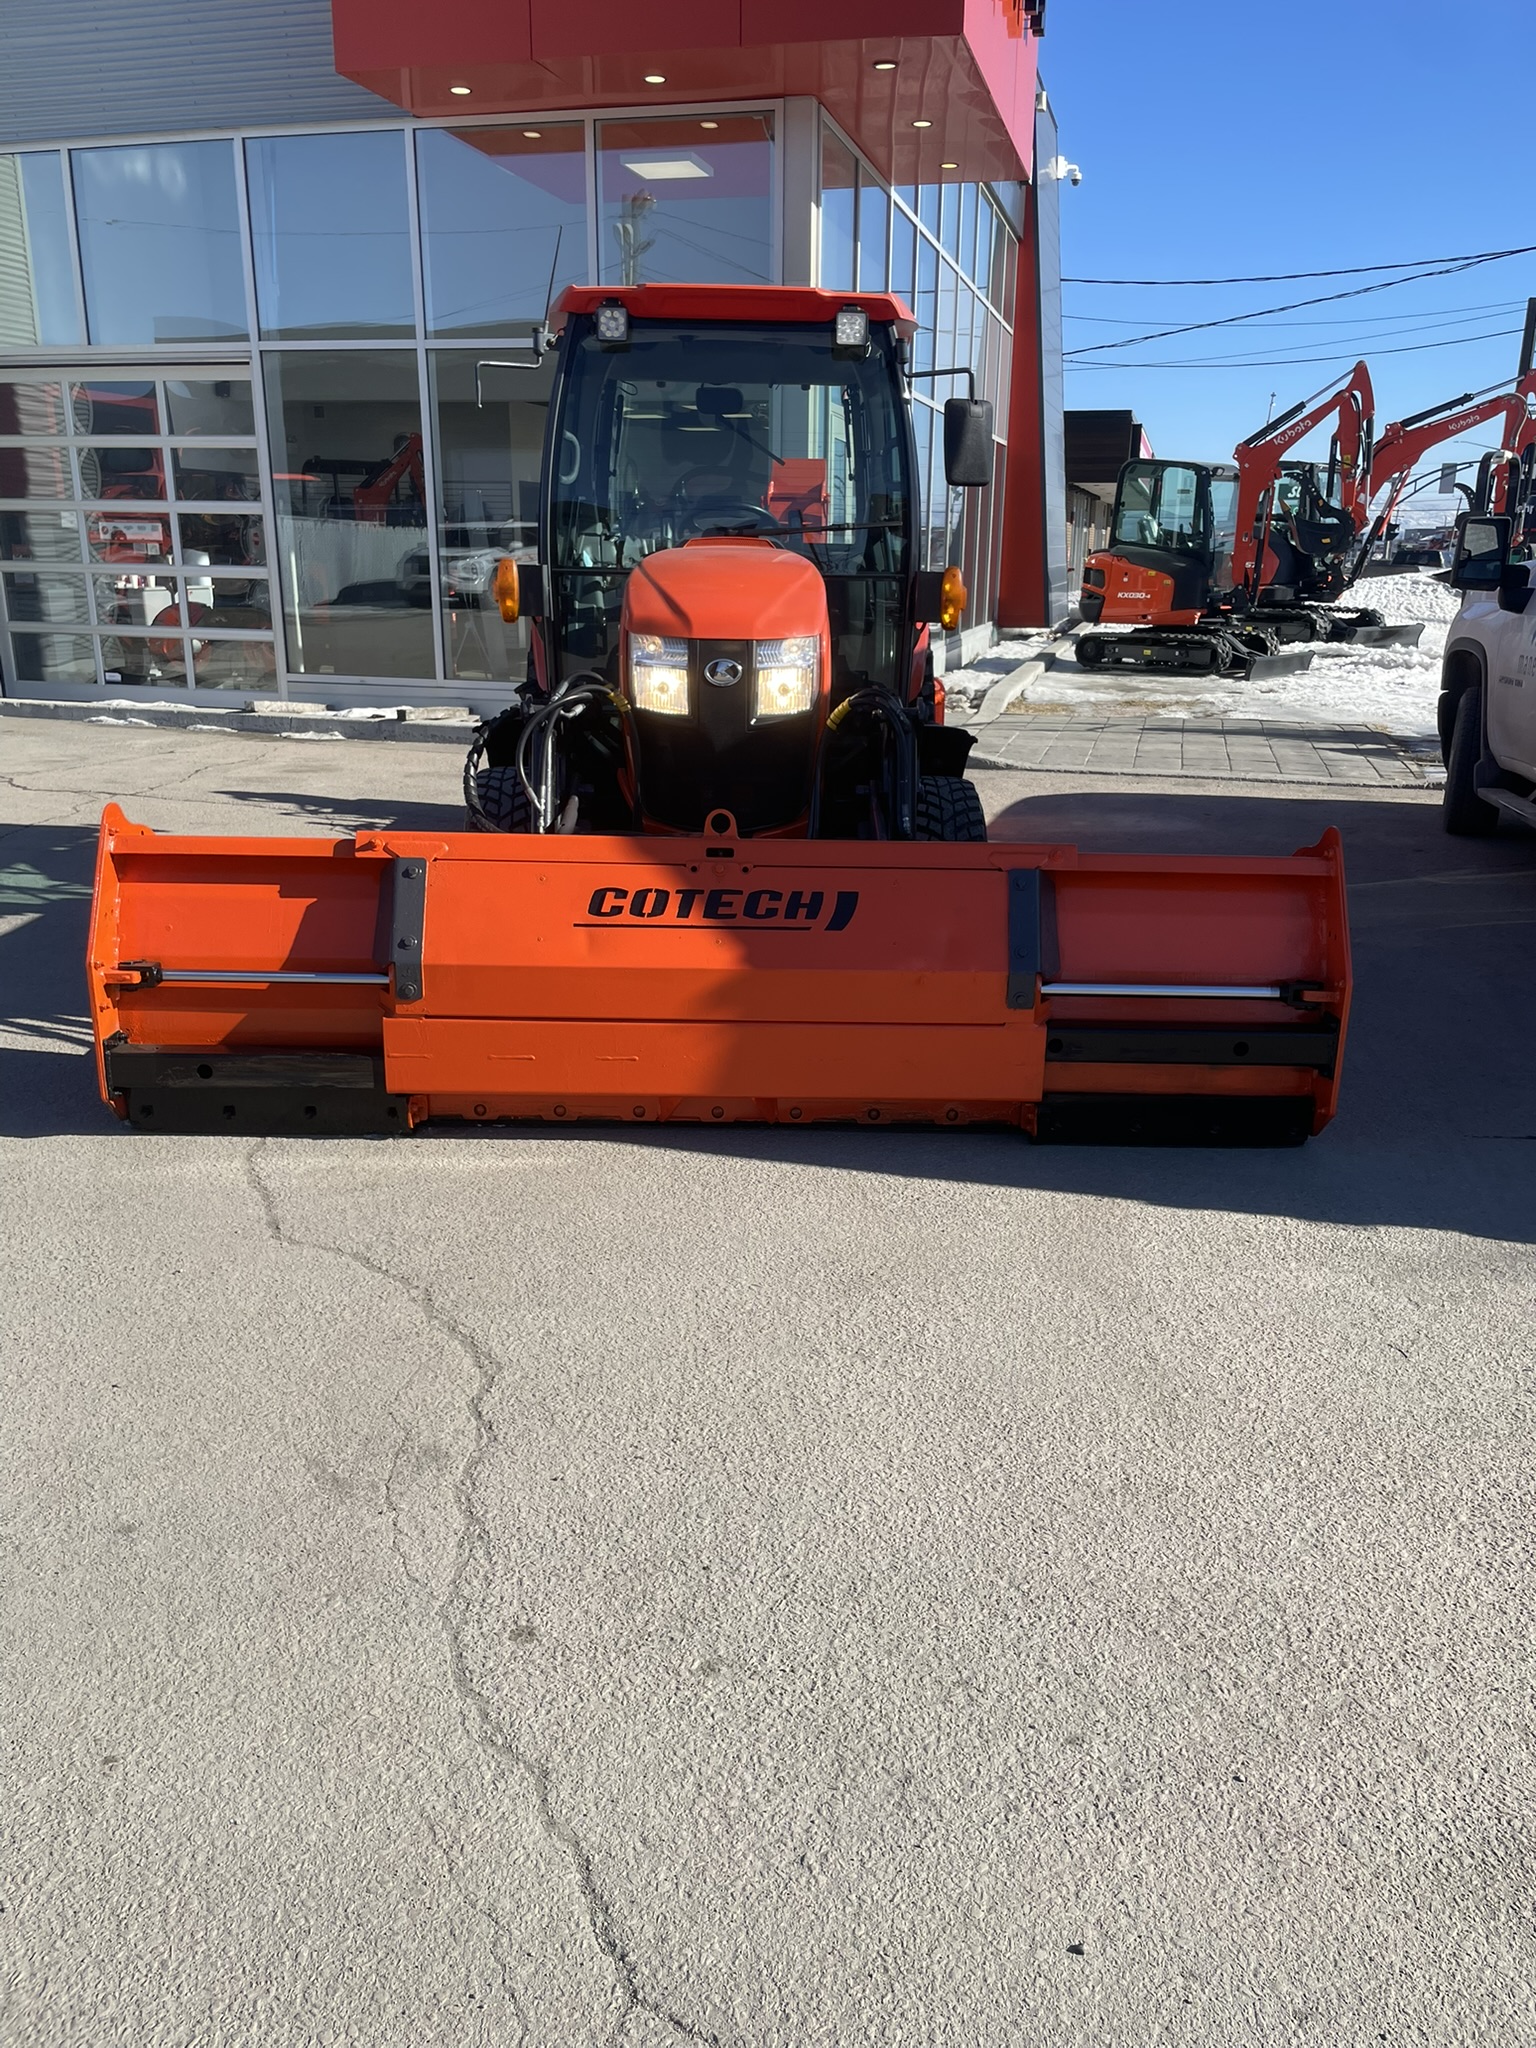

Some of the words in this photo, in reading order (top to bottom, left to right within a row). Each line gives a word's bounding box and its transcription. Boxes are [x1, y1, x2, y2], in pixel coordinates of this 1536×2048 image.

[1273, 419, 1312, 445] Kubota
[1449, 414, 1480, 430] Kubota
[587, 887, 824, 919] COTECH
